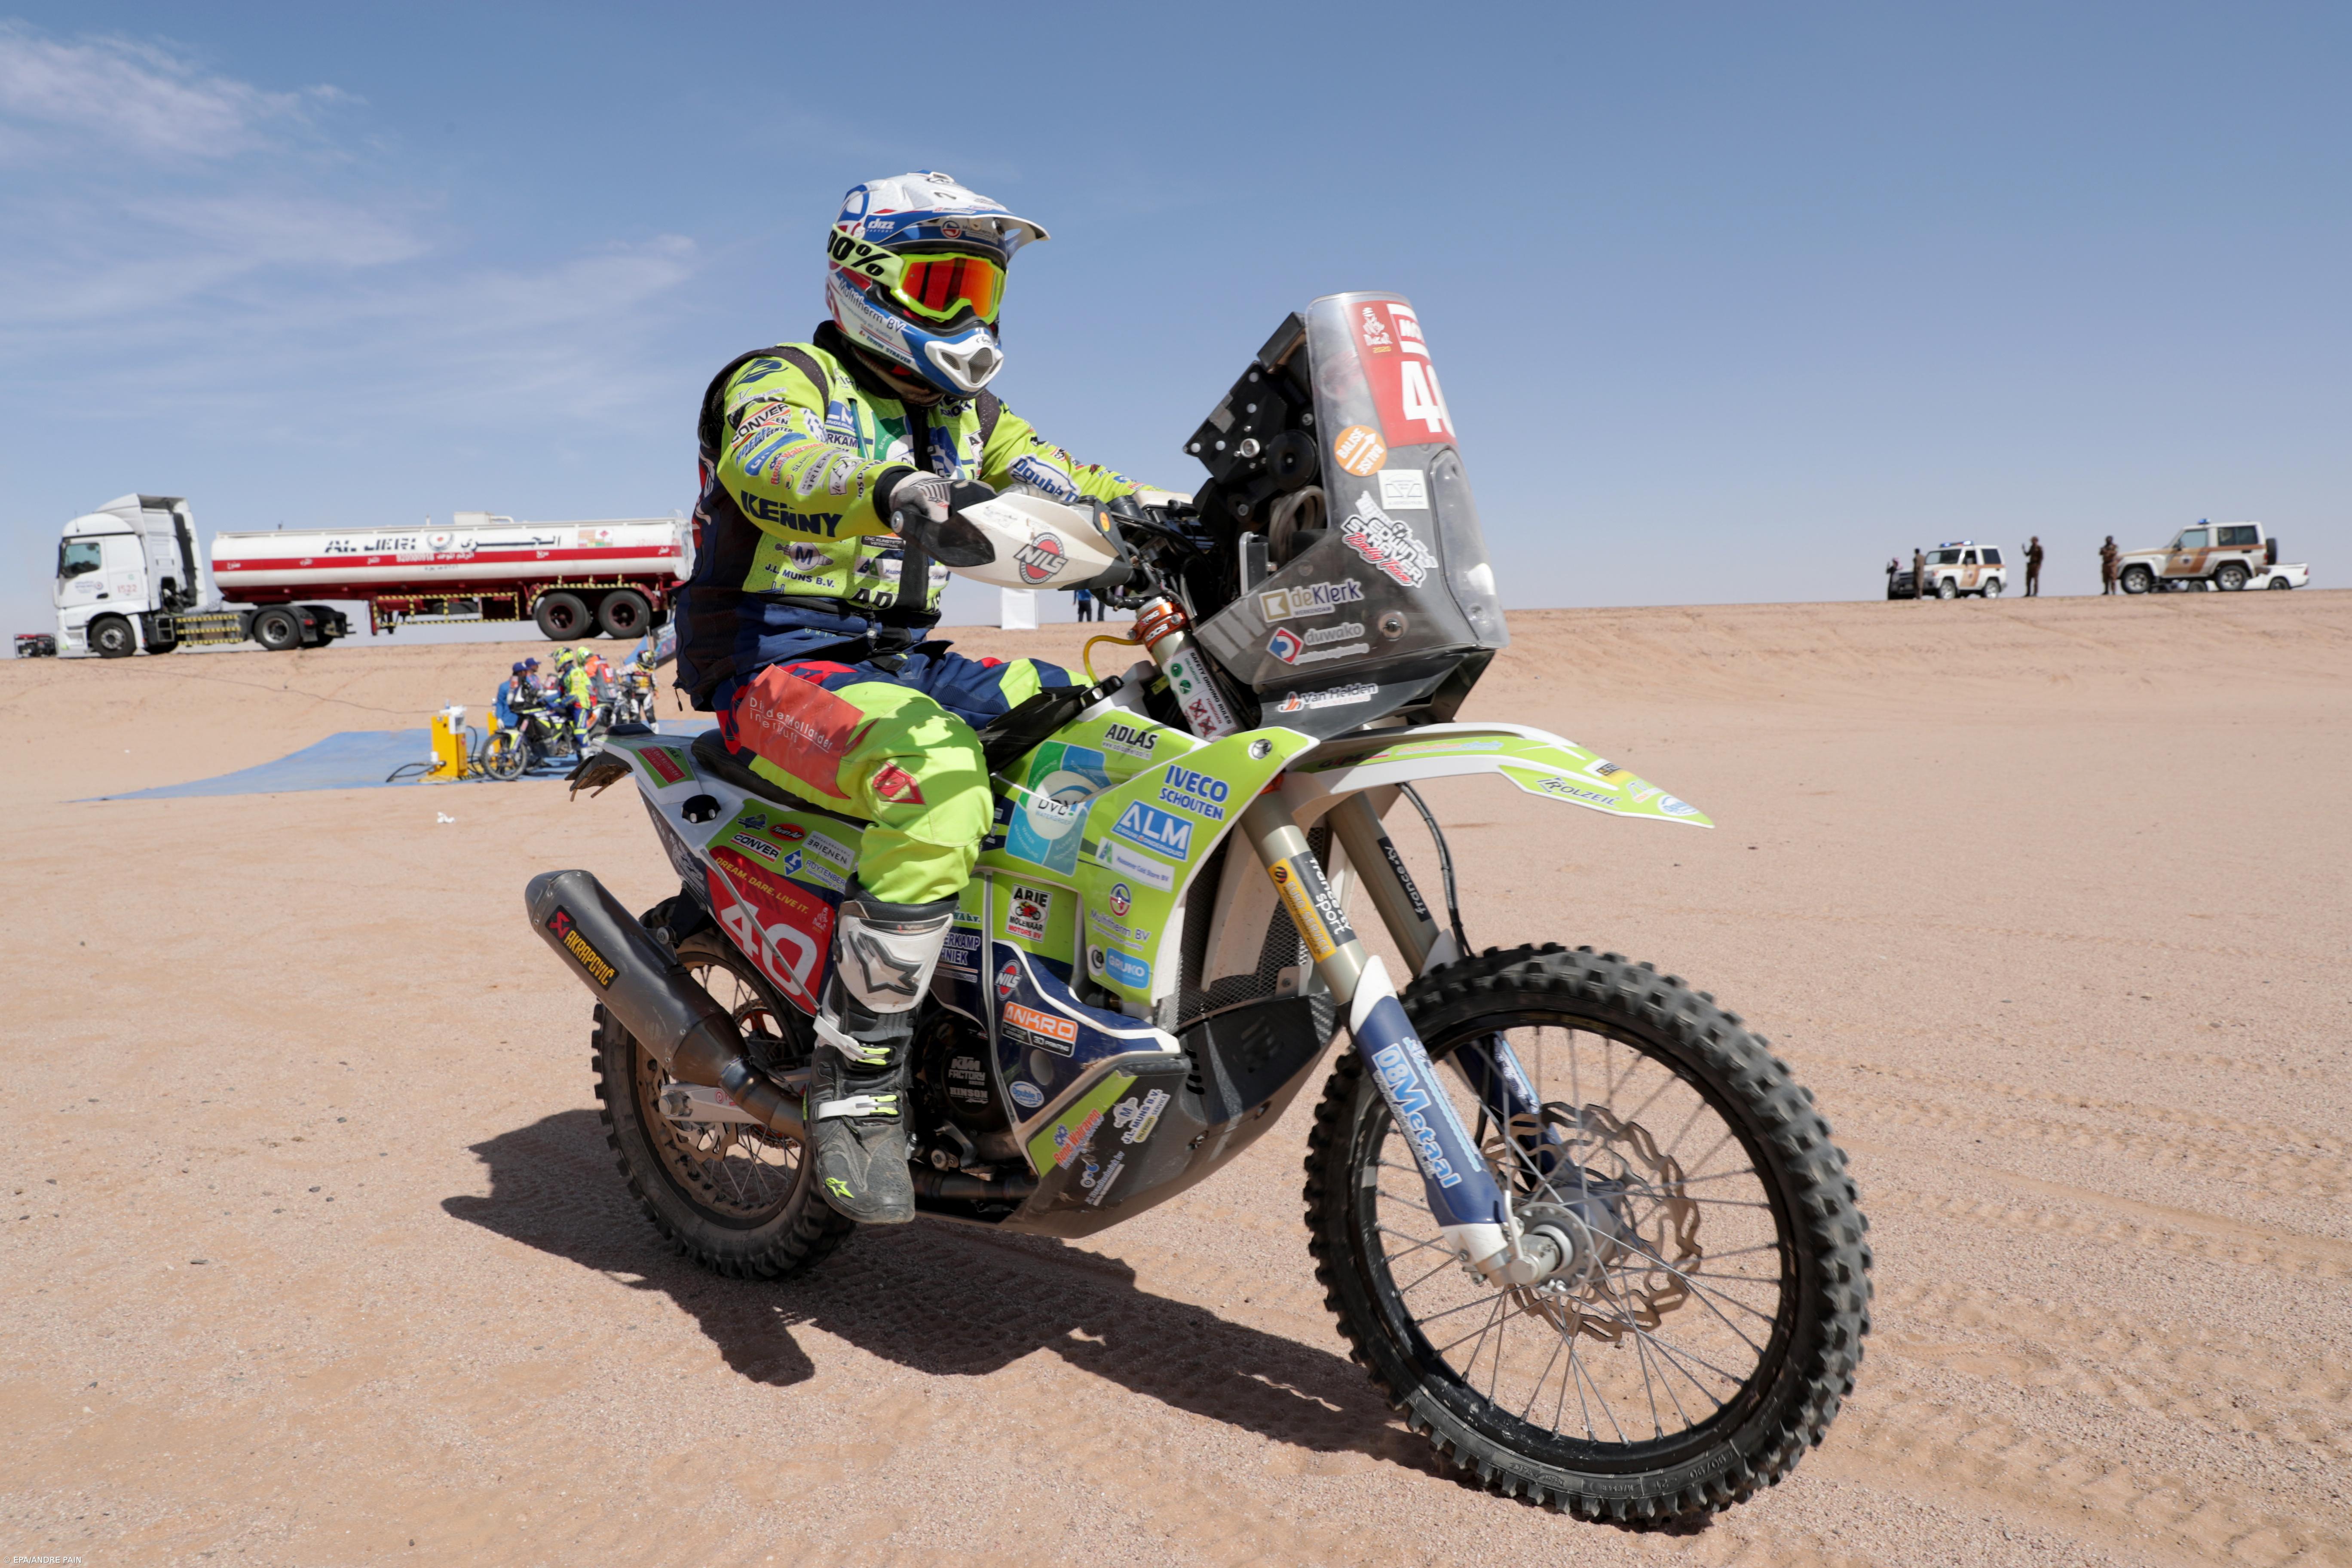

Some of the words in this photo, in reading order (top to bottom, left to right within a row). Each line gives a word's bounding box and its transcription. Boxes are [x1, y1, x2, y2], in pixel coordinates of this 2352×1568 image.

[839, 279, 883, 323] Multitherm
[887, 317, 905, 332] BV
[867, 335, 883, 349] EDWIN
[885, 346, 912, 364] STRAVER
[1336, 428, 1366, 459] BALISE
[1356, 444, 1384, 475] BALISE
[741, 490, 843, 537] KENNY
[1345, 518, 1423, 581] STRAVER
[1368, 519, 1418, 561] EDWIN
[795, 545, 813, 565] M
[1017, 545, 1067, 574] NILS
[1345, 532, 1385, 560] Rally
[1380, 558, 1412, 582] Team
[117, 584, 138, 594] 1522
[765, 564, 779, 574] J.L.
[782, 569, 813, 583] MUNS
[816, 577, 835, 588] B.V.
[1292, 581, 1361, 607] deKlerk
[1307, 624, 1362, 644] duwako
[1184, 658, 1201, 684] OBLIGATORY
[1190, 652, 1206, 675] SAFETY
[1203, 675, 1220, 702] DRIVING
[1218, 703, 1232, 725] RULES
[1302, 694, 1327, 703] Van
[1329, 684, 1376, 698] Helden
[1206, 698, 1223, 724] FORBIDDEN
[1105, 724, 1158, 750] ADLAS
[1164, 765, 1228, 803] IVECO
[1159, 787, 1223, 820] SCHOUTEN
[1119, 804, 1191, 850] ALM
[734, 835, 779, 858] CONVER
[716, 857, 747, 880] DREAM.
[748, 876, 775, 896] DARE.
[775, 891, 798, 907] LIVE
[797, 903, 808, 914] IT.
[1013, 887, 1048, 908] ARIE
[1009, 916, 1043, 932] MOLENAAR
[1315, 893, 1345, 935] sport
[1008, 924, 1032, 937] MOTORS
[1032, 931, 1042, 940] BV
[1135, 928, 1151, 941] BV
[564, 930, 615, 986] AKRAPOVIČ
[720, 900, 817, 996] 40
[995, 971, 1021, 988] NILS
[1108, 955, 1145, 977] GRUKO
[1005, 1005, 1075, 1038] ANKRO
[948, 1069, 986, 1081] FACTORY
[951, 1056, 981, 1071] KTM
[1119, 1107, 1133, 1117] M
[1124, 1129, 1136, 1143] J.L.
[1132, 1106, 1150, 1128] MUNS
[1146, 1090, 1160, 1105] B.V.
[1152, 1095, 1168, 1115] SERVICE
[1053, 1142, 1073, 1166] Rene
[1068, 1108, 1102, 1146] Walraven
